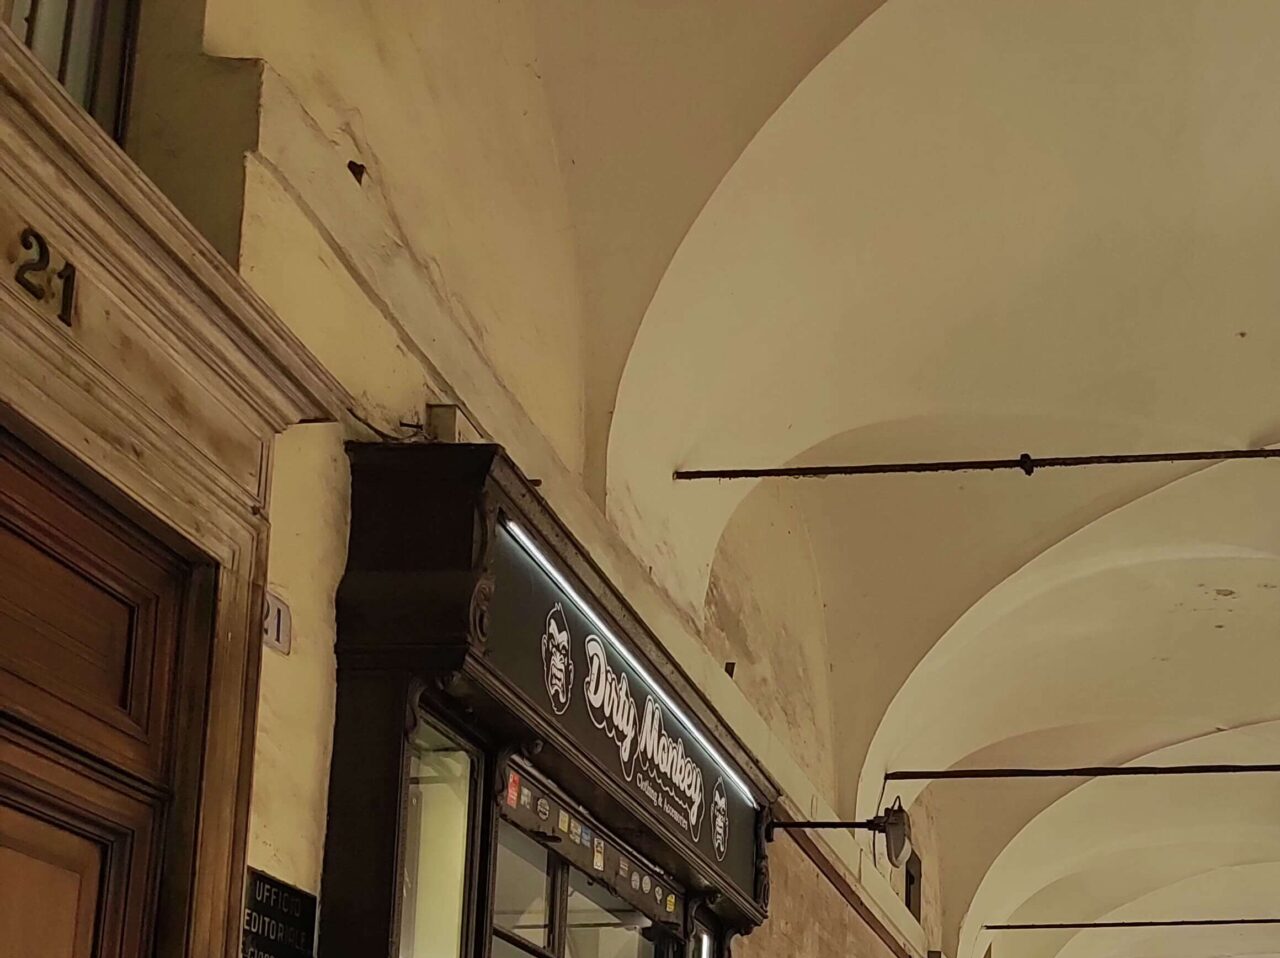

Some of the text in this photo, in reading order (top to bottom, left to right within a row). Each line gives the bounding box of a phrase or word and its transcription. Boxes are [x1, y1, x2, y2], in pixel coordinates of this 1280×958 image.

[15, 228, 75, 327] 21
[586, 638, 702, 826] Dirty Monkey
[636, 772, 658, 806] Clothing
[255, 879, 300, 917] UFFICIO
[243, 908, 307, 951] EDITORIALE
